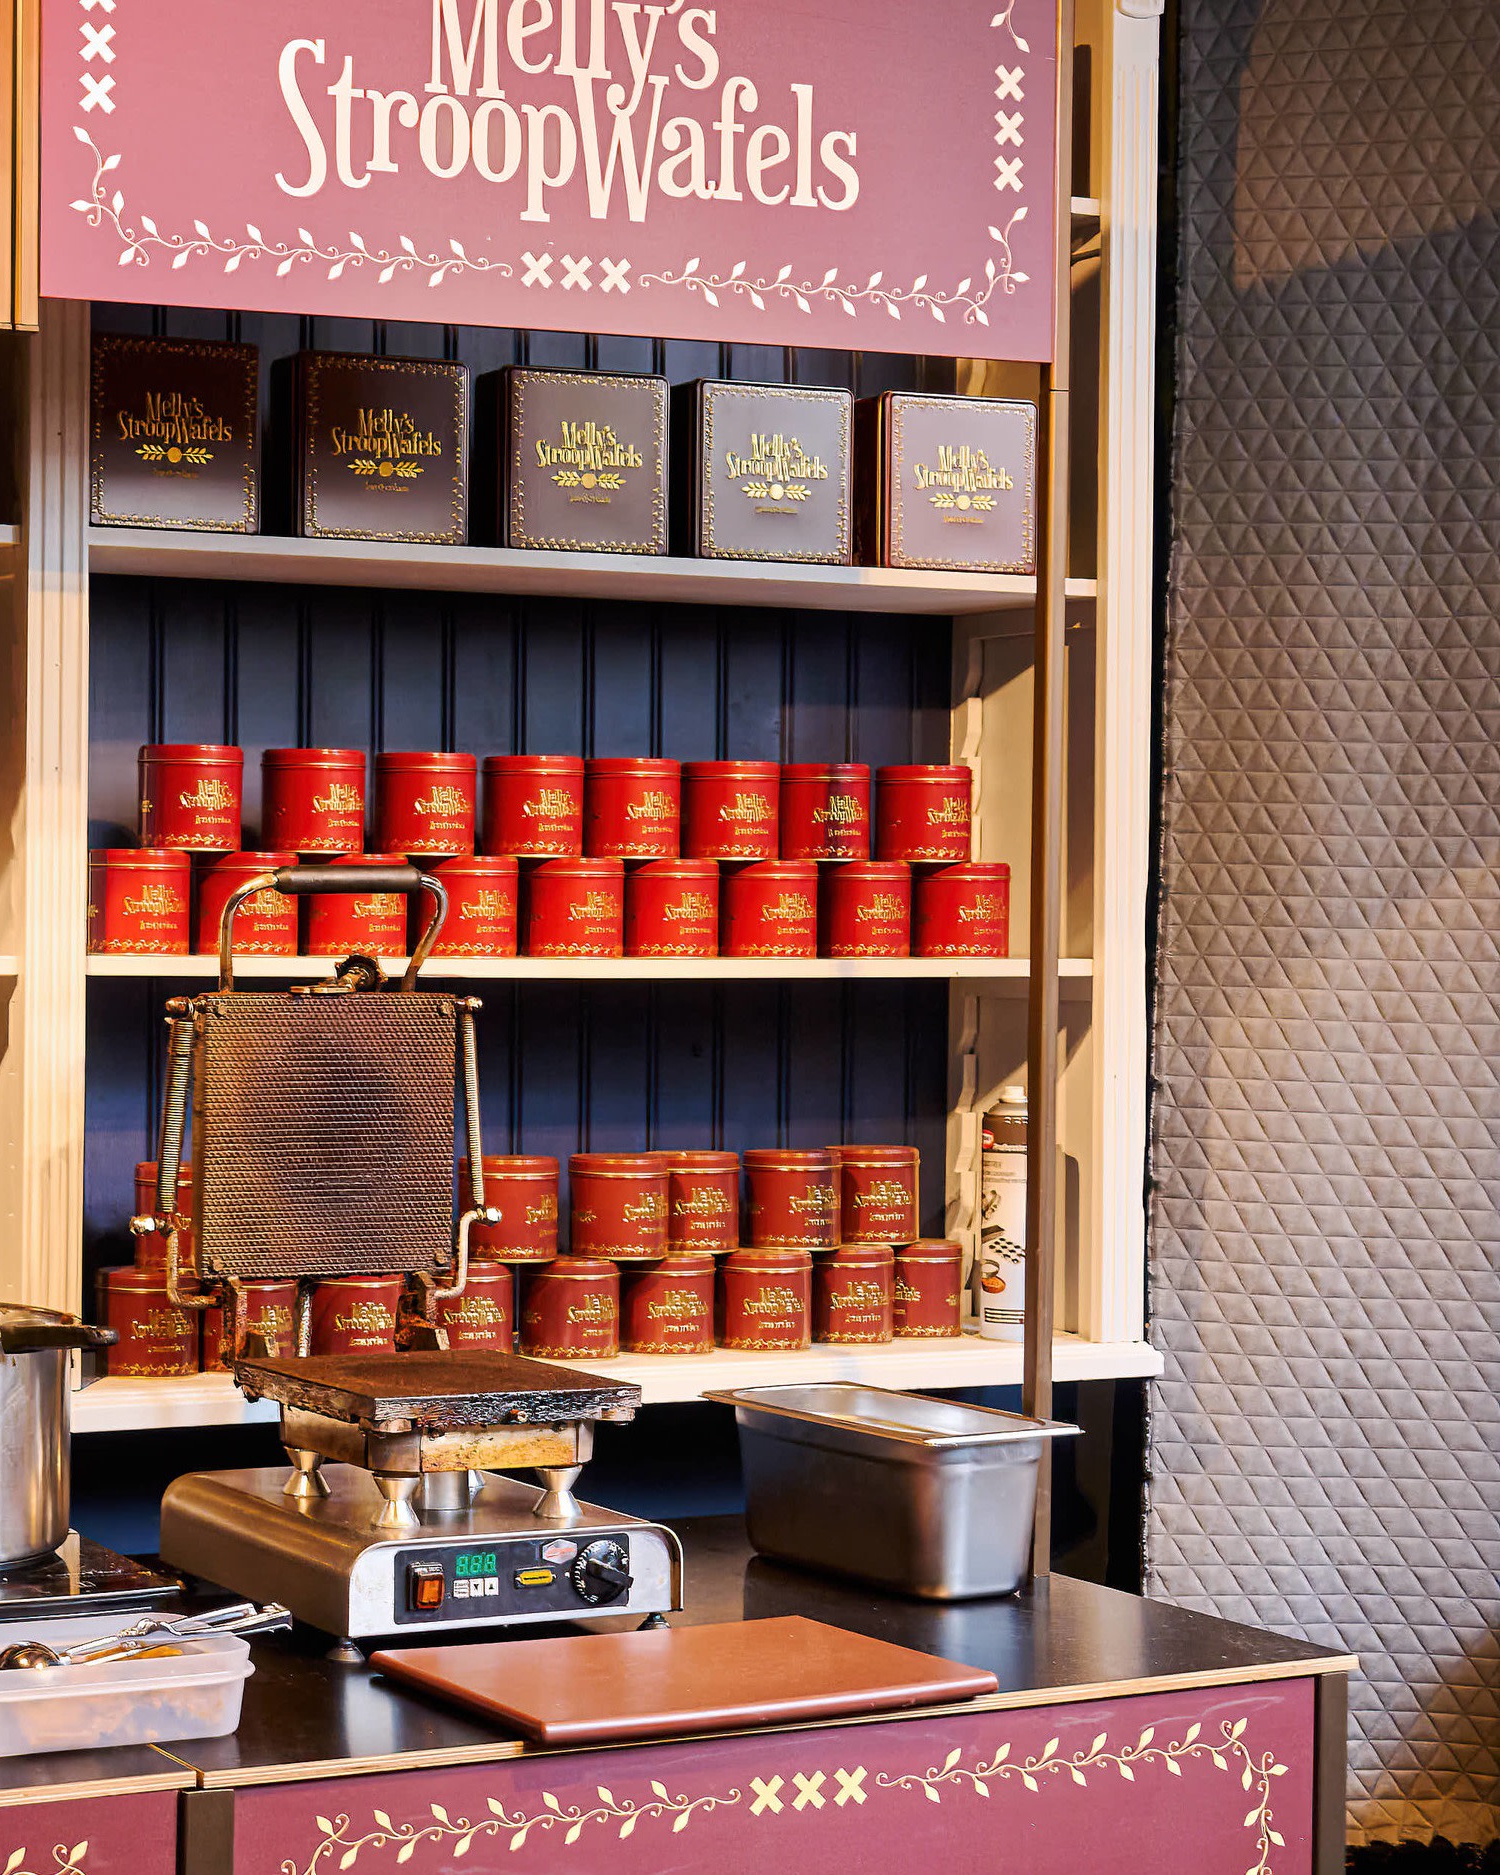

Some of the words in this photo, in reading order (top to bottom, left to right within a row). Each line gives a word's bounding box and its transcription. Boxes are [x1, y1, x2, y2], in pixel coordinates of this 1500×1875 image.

[275, 38, 860, 222] StroopWafels
[147, 391, 203, 423] Melly's
[359, 409, 414, 438] Melly's
